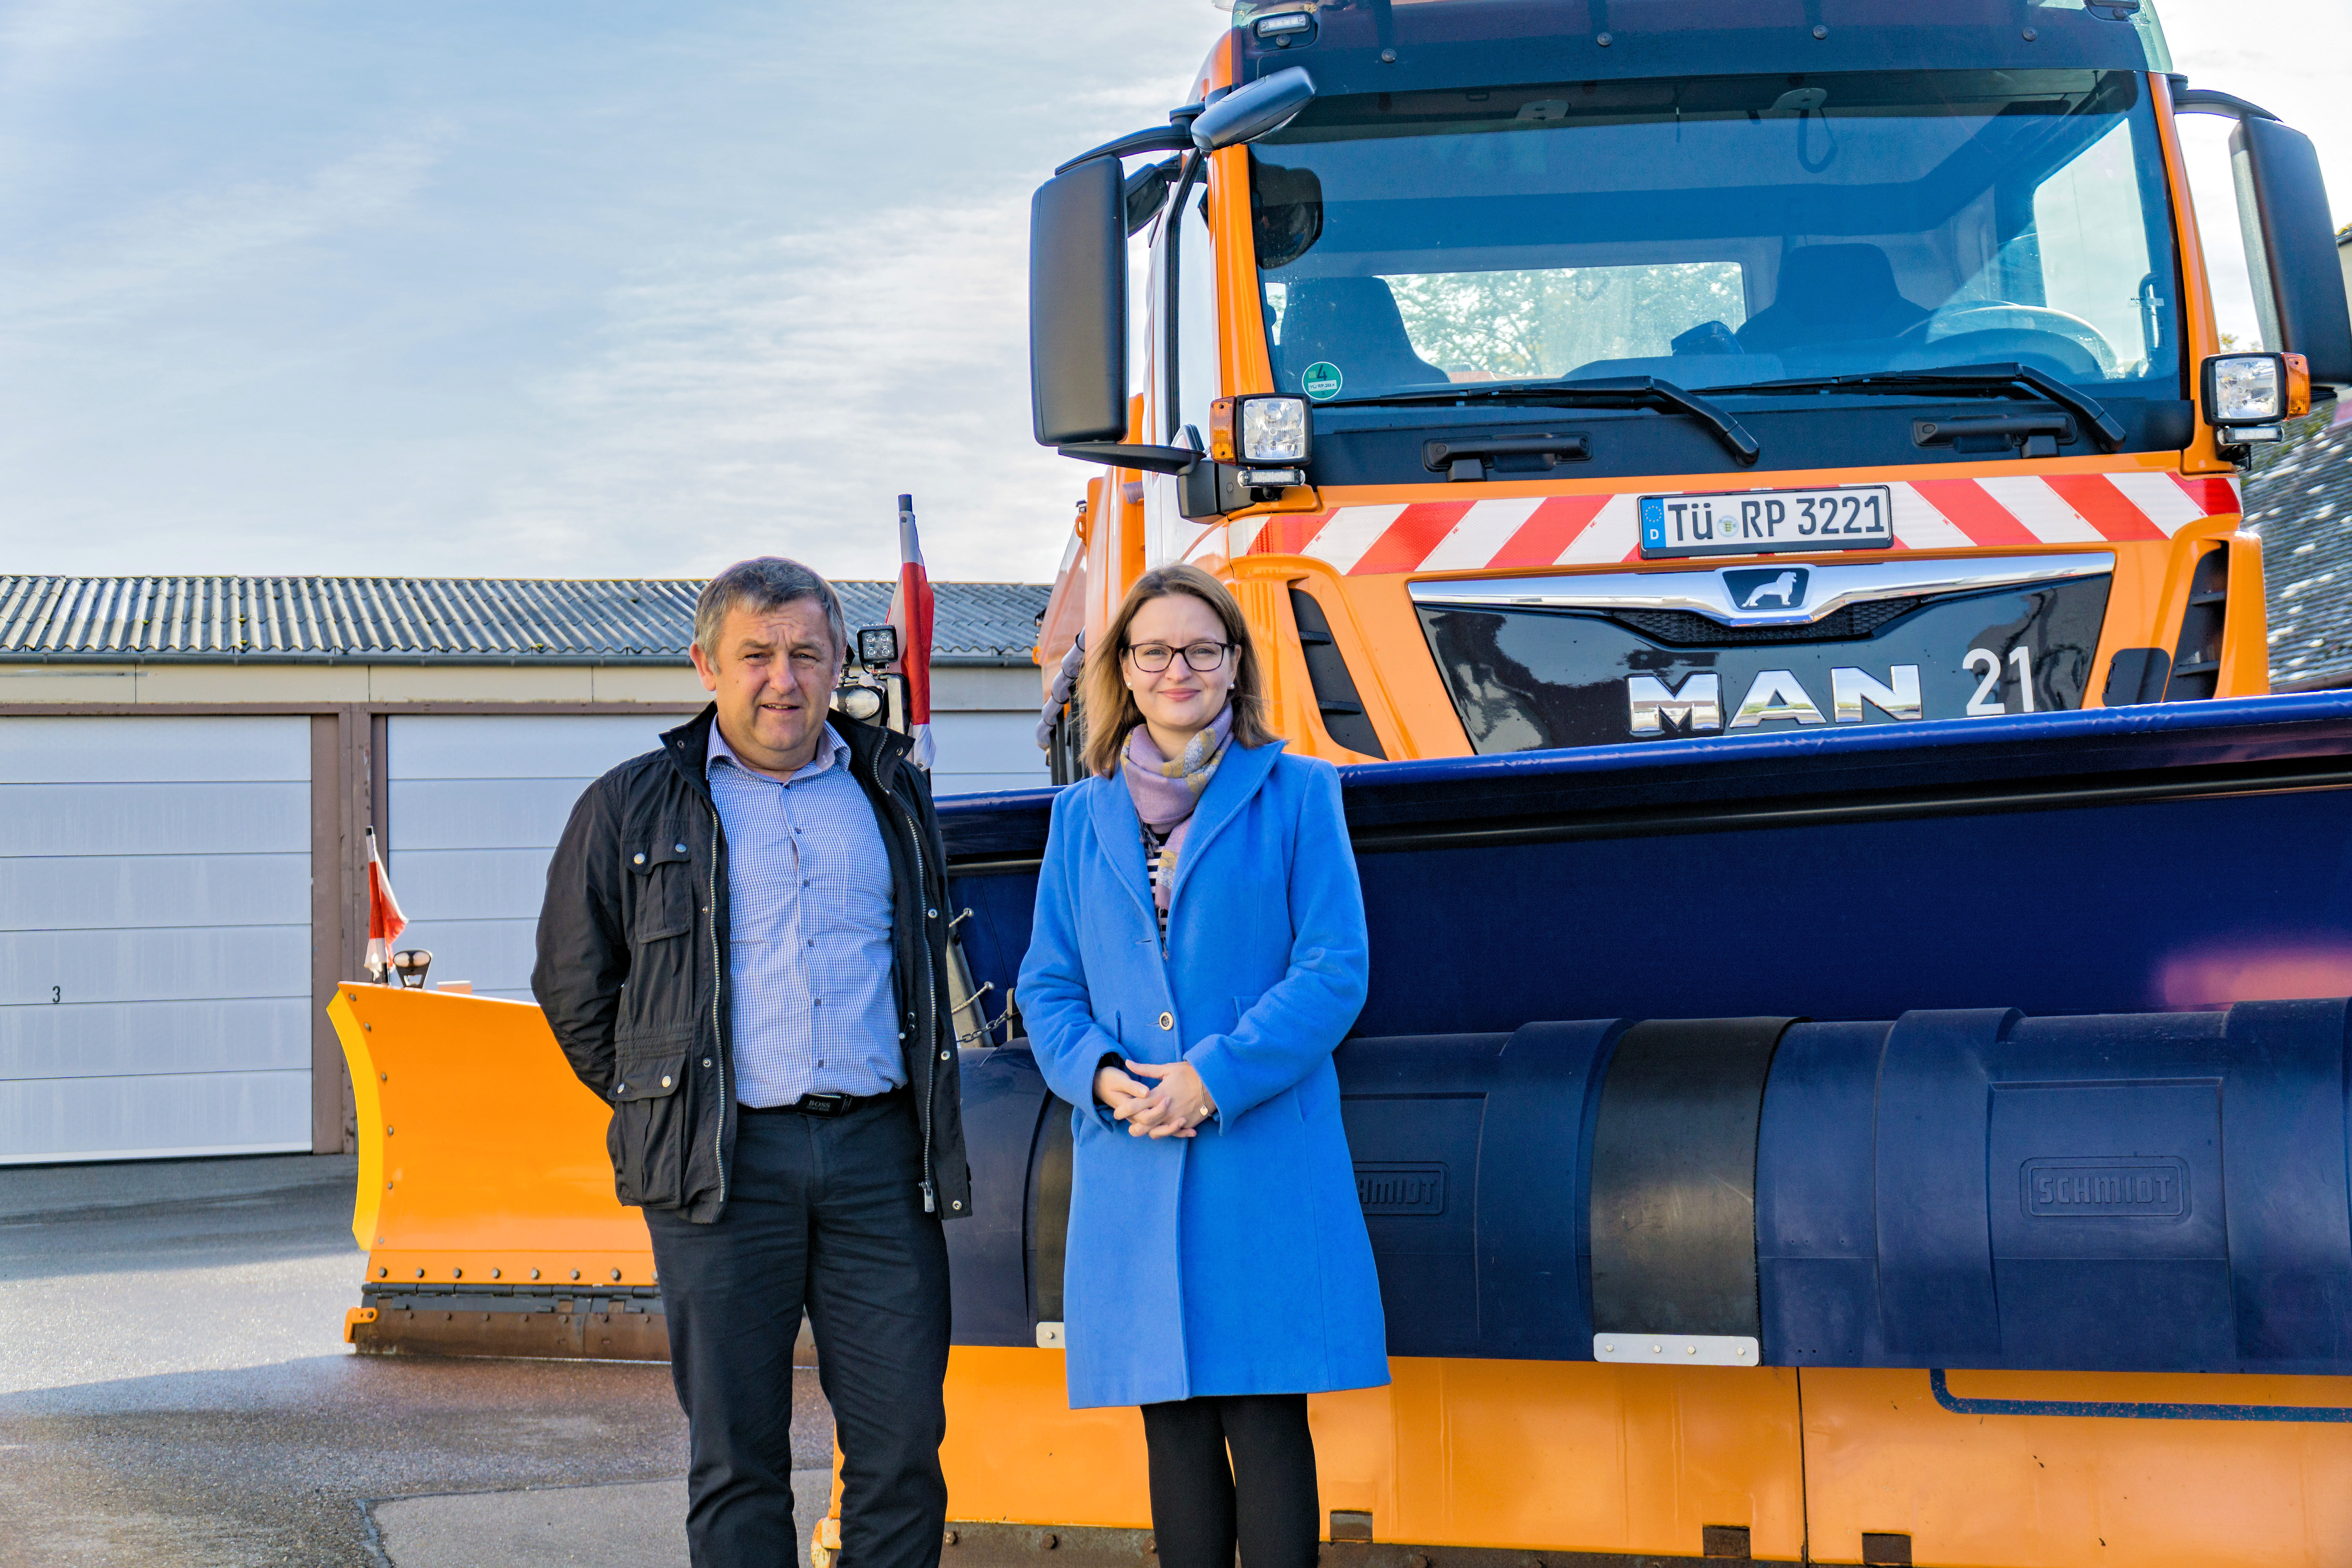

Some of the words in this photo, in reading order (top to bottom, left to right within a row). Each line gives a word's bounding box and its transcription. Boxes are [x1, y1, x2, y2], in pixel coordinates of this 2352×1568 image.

[1317, 364, 1328, 380] 4
[1668, 503, 1713, 541] TÜ
[1741, 499, 1785, 538] RP
[1796, 495, 1885, 535] 3221
[1650, 528, 1659, 540] D
[1962, 646, 2035, 716] 21
[1628, 663, 1924, 732] MAN
[52, 985, 60, 1003] 3
[809, 1100, 831, 1108] BOSS
[1359, 1178, 1437, 1204] HMIDT
[2039, 1176, 2171, 1204] SCHMIDT
